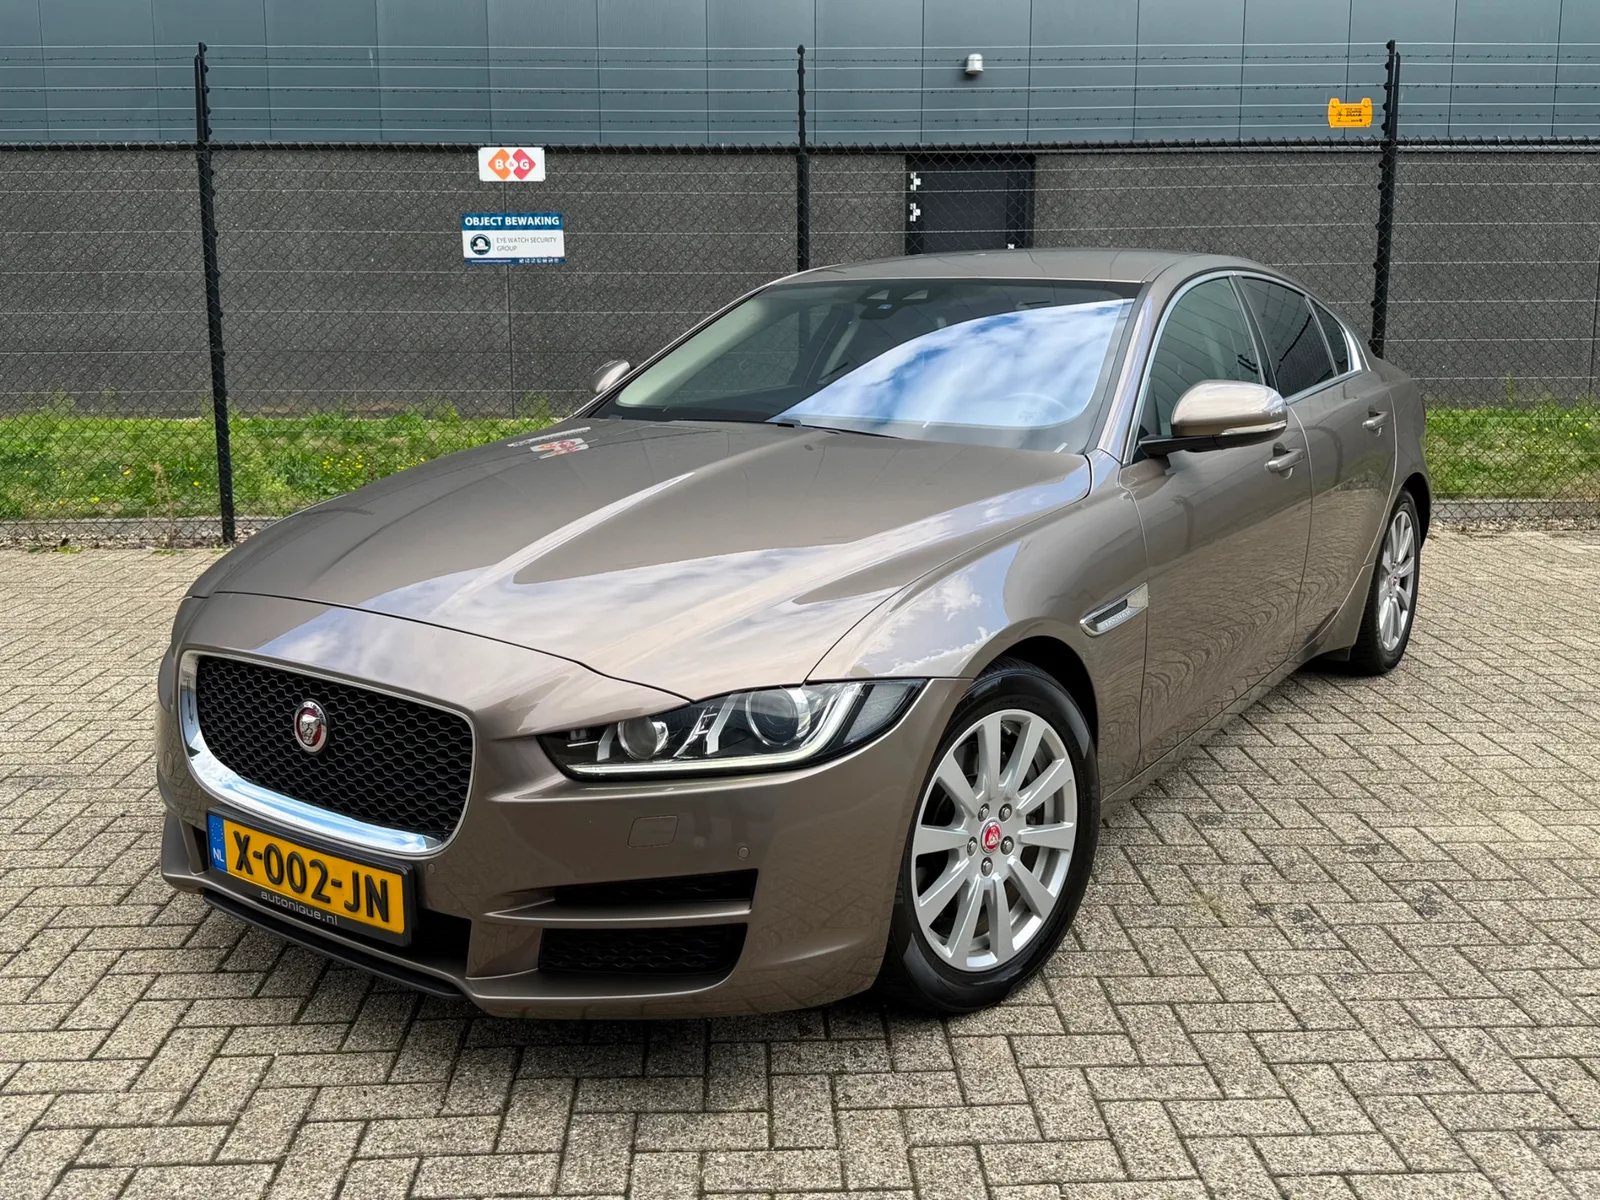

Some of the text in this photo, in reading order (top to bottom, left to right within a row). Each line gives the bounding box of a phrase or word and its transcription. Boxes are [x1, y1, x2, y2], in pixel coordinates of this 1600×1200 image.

[464, 216, 560, 226] OBJECT BEWAKING
[529, 236, 557, 244] SECURITY
[213, 847, 225, 863] NL
[233, 830, 390, 923] X-002-JN
